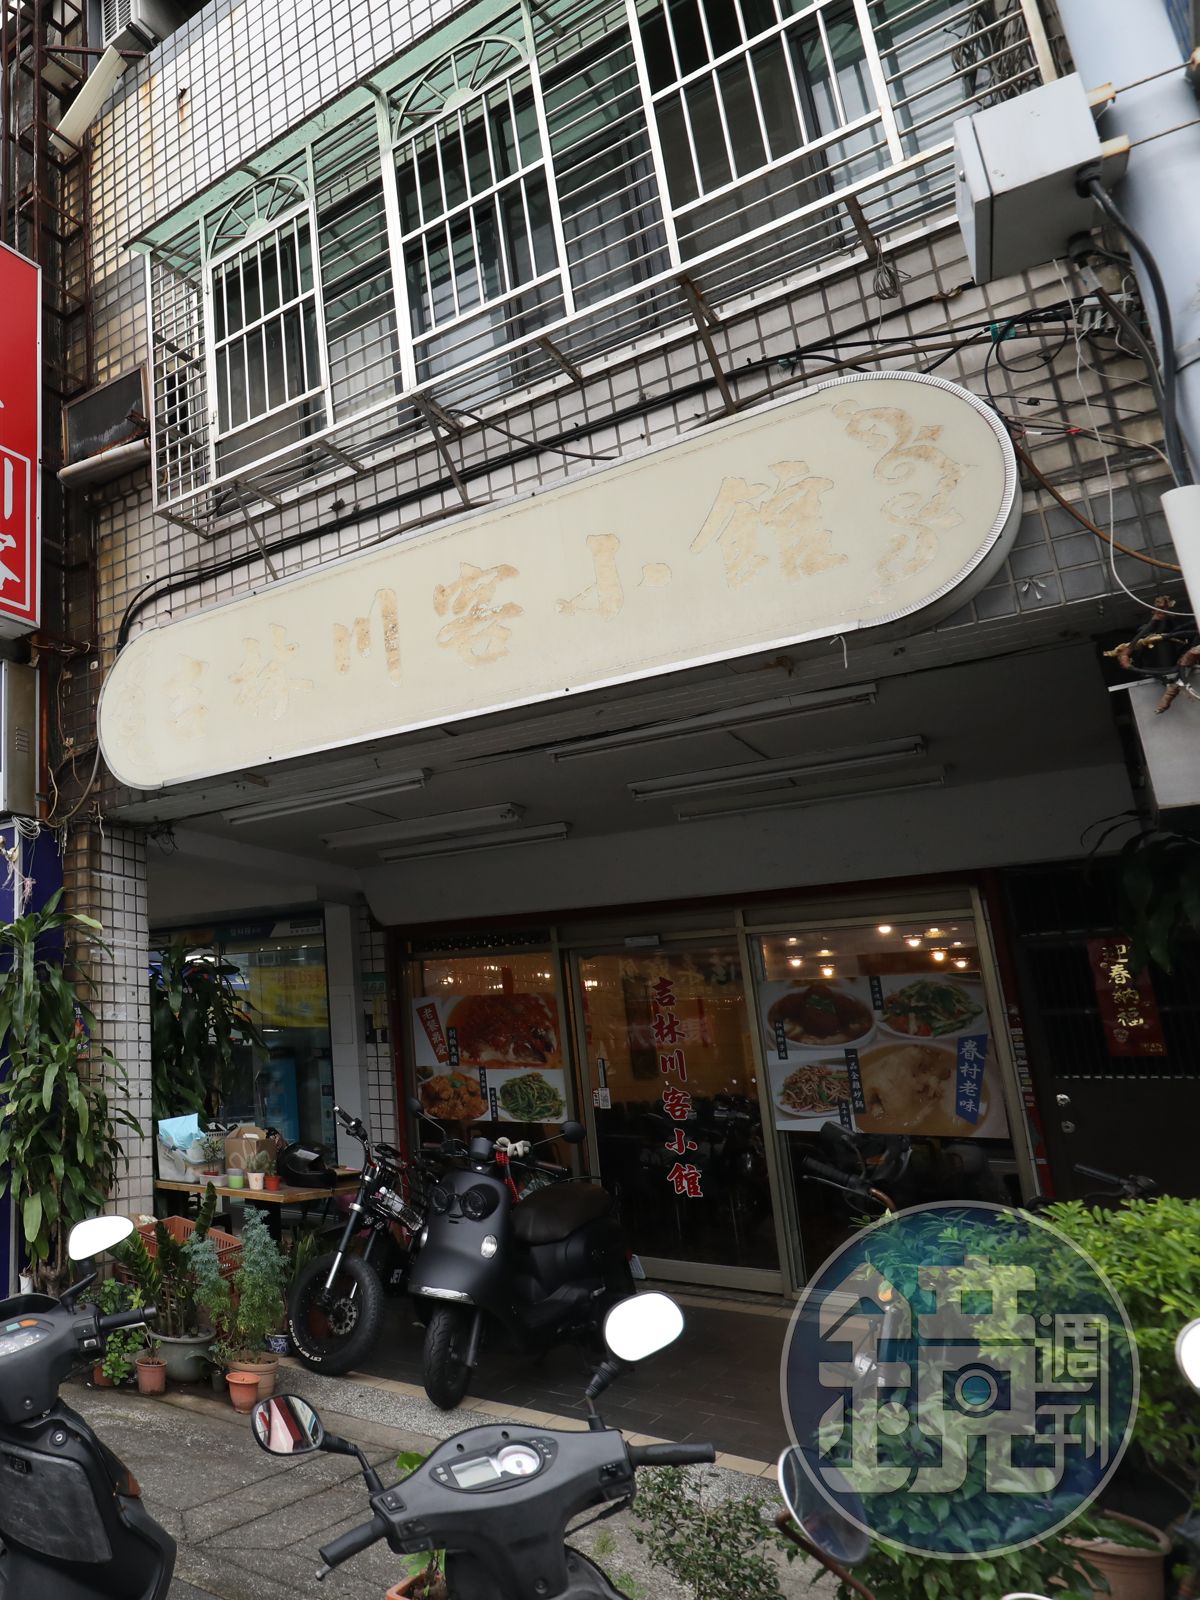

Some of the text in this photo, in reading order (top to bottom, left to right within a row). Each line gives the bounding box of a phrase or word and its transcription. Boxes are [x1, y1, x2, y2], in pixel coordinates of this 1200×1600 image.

[651, 976, 704, 1198] 吉林川客小館
